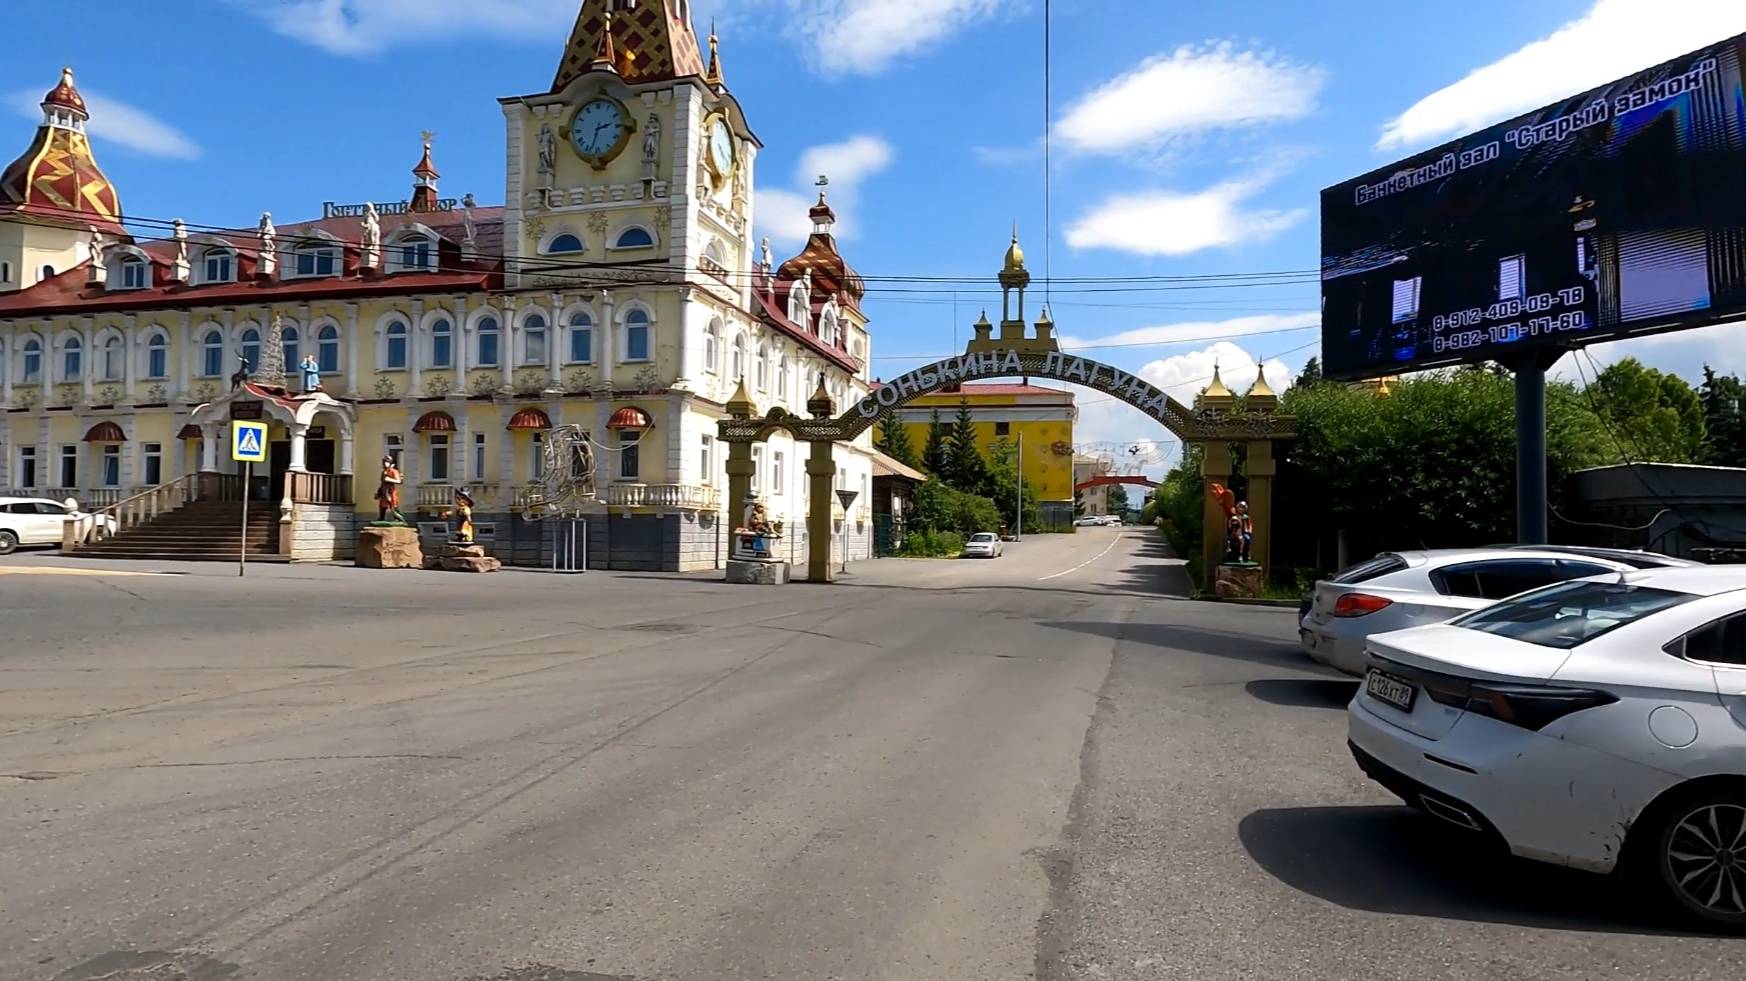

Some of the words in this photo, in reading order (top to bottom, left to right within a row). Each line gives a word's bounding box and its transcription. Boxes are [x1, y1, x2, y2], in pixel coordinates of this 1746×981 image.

[1355, 152, 1456, 206] Банкетный
[1460, 140, 1500, 170] зал
[323, 199, 409, 219] Гостный
[1432, 286, 1584, 332] 8-912-409-09-78
[1433, 310, 1585, 353] 8-982-107-17-60
[857, 349, 1024, 419] СОНЬКИНА
[1042, 351, 1170, 419] ЛАГУНА
